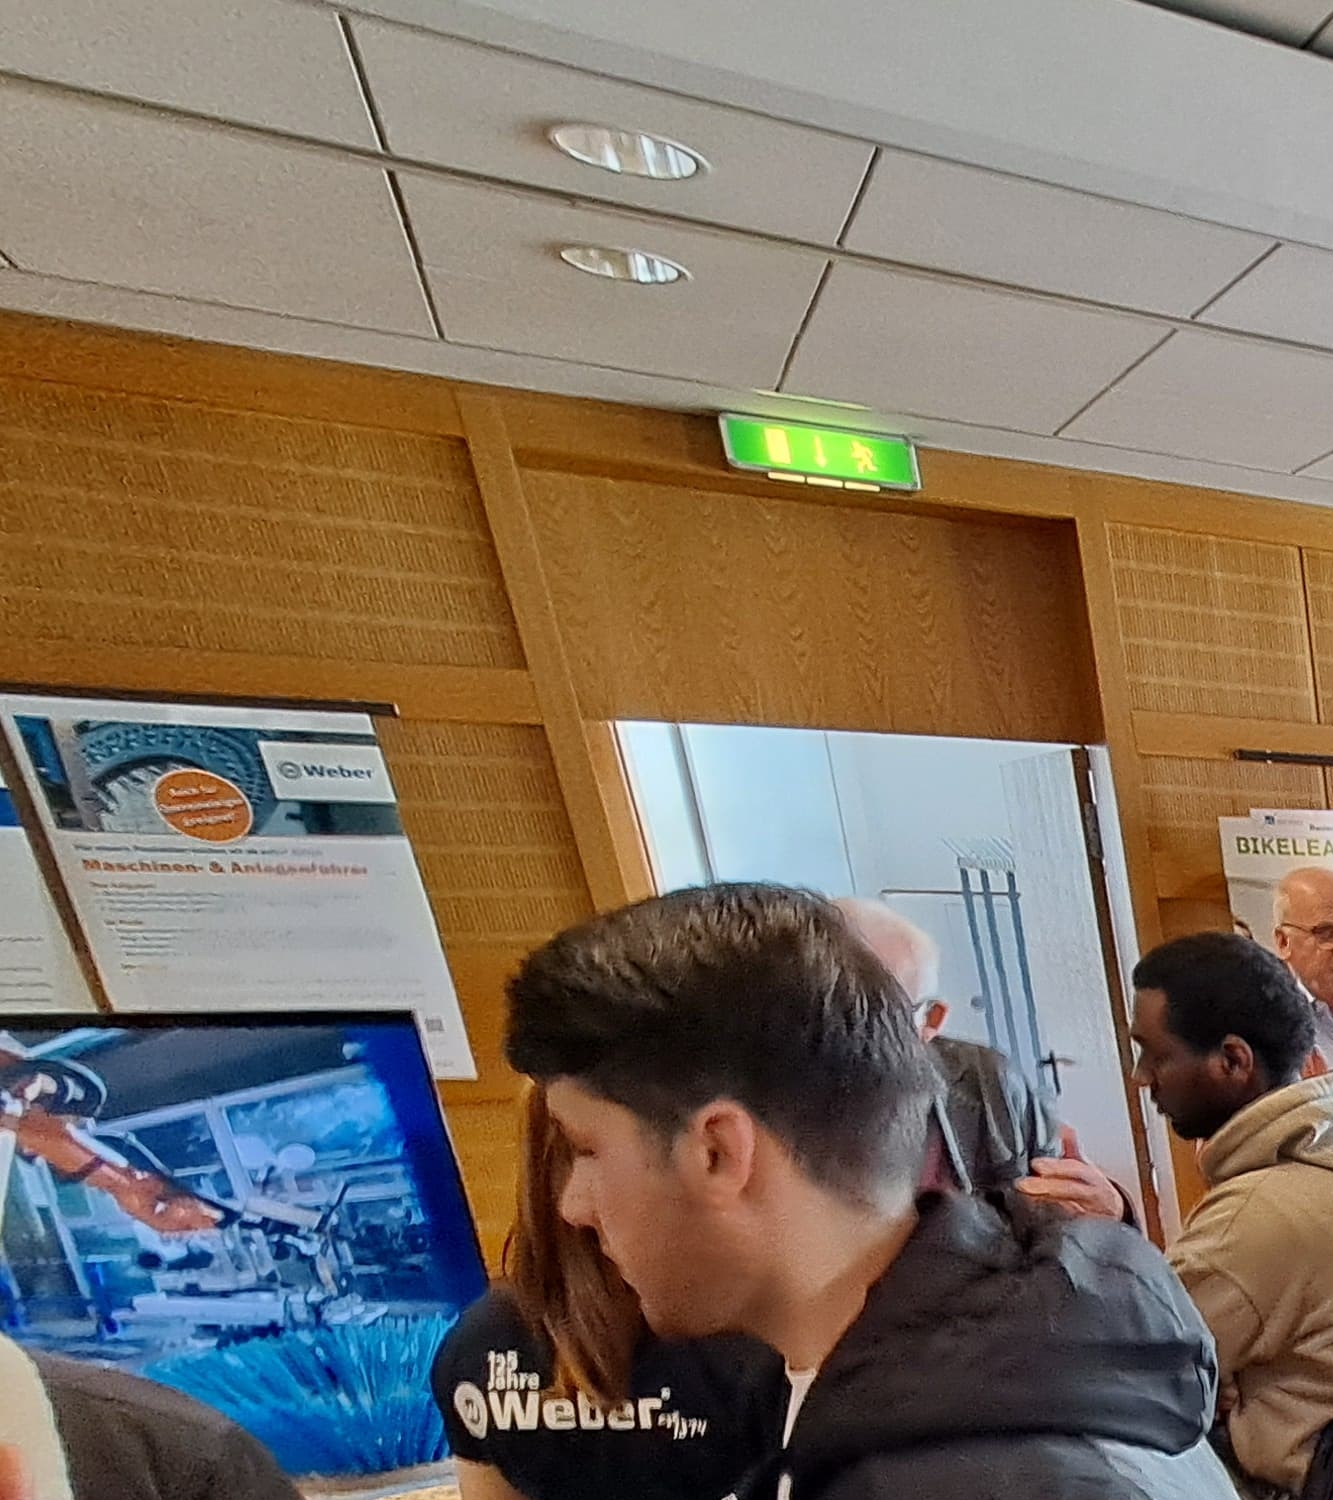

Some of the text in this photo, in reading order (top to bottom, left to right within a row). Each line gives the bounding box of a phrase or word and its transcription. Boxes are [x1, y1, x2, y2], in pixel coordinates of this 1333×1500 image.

[304, 764, 374, 780] Weber
[82, 857, 204, 875] Maschinen-
[208, 861, 226, 875] &
[487, 1390, 663, 1431] Weber
